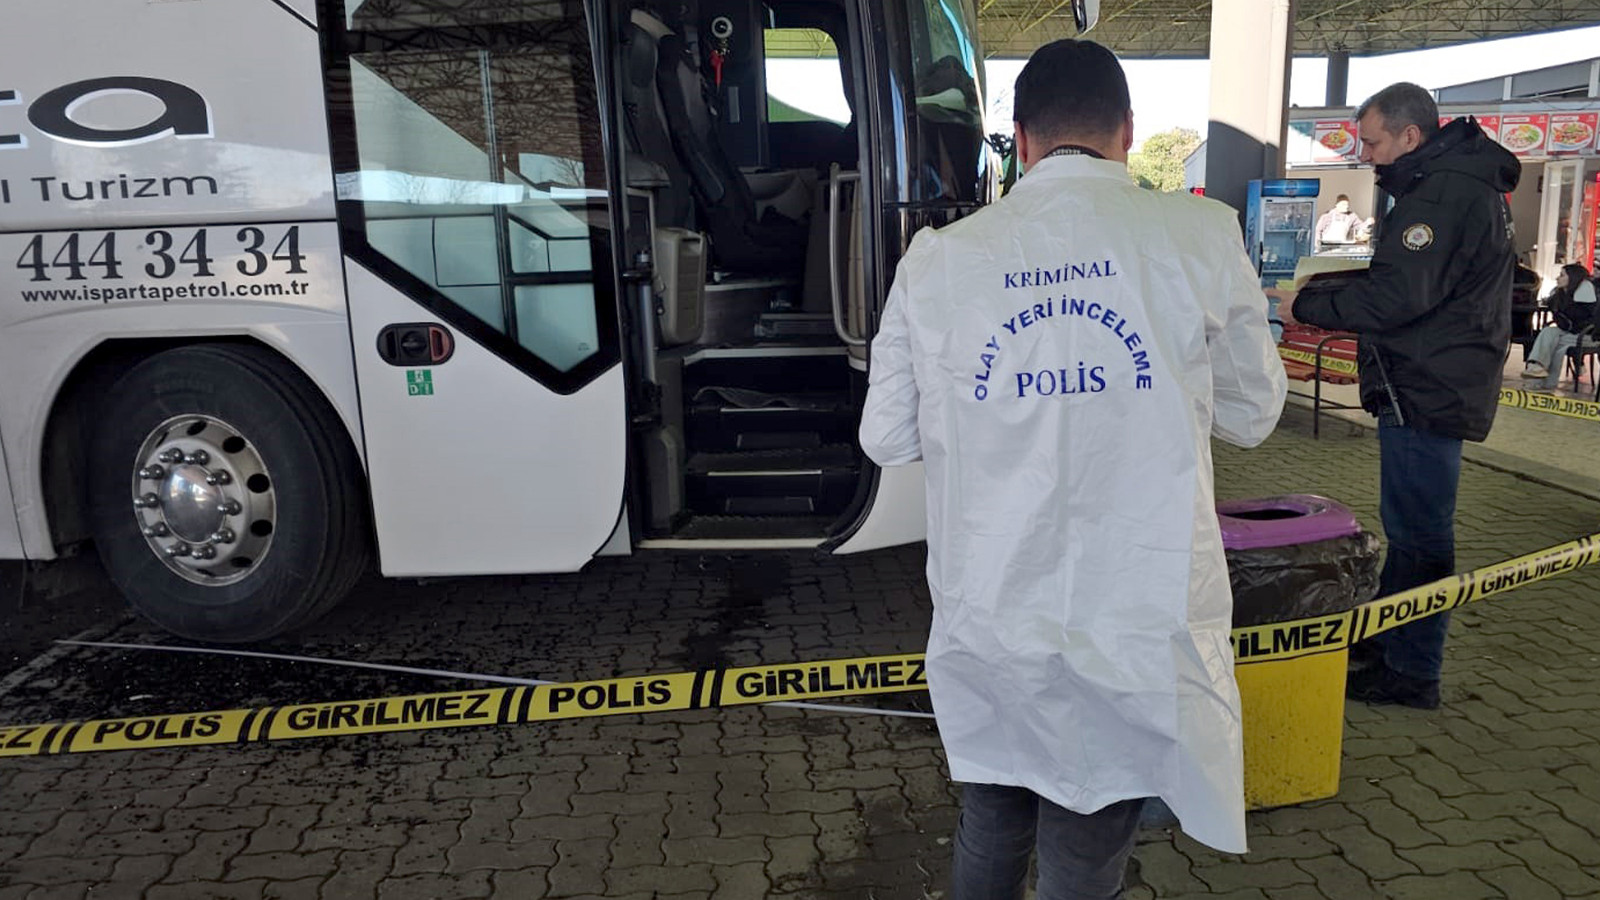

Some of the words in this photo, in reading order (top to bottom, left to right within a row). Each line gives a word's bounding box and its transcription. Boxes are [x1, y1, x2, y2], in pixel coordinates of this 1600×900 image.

[31, 174, 218, 201] Turizm
[16, 231, 123, 282] 444
[144, 228, 215, 279] 34
[236, 225, 308, 277] 34
[1004, 260, 1117, 289] KRİMİNAL
[21, 280, 309, 303] www.ispartapetrol.com.tr
[974, 335, 1001, 401] OLAY
[1002, 297, 1053, 335] YERİ
[1061, 294, 1152, 390] İNCELEME
[1015, 361, 1107, 398] POLİS
[1230, 618, 1344, 659] İLMEZ
[1377, 589, 1448, 629] POLİS
[94, 714, 223, 744] POLİS
[287, 693, 491, 731] GİRİLMEZ
[548, 679, 672, 713] POLİS
